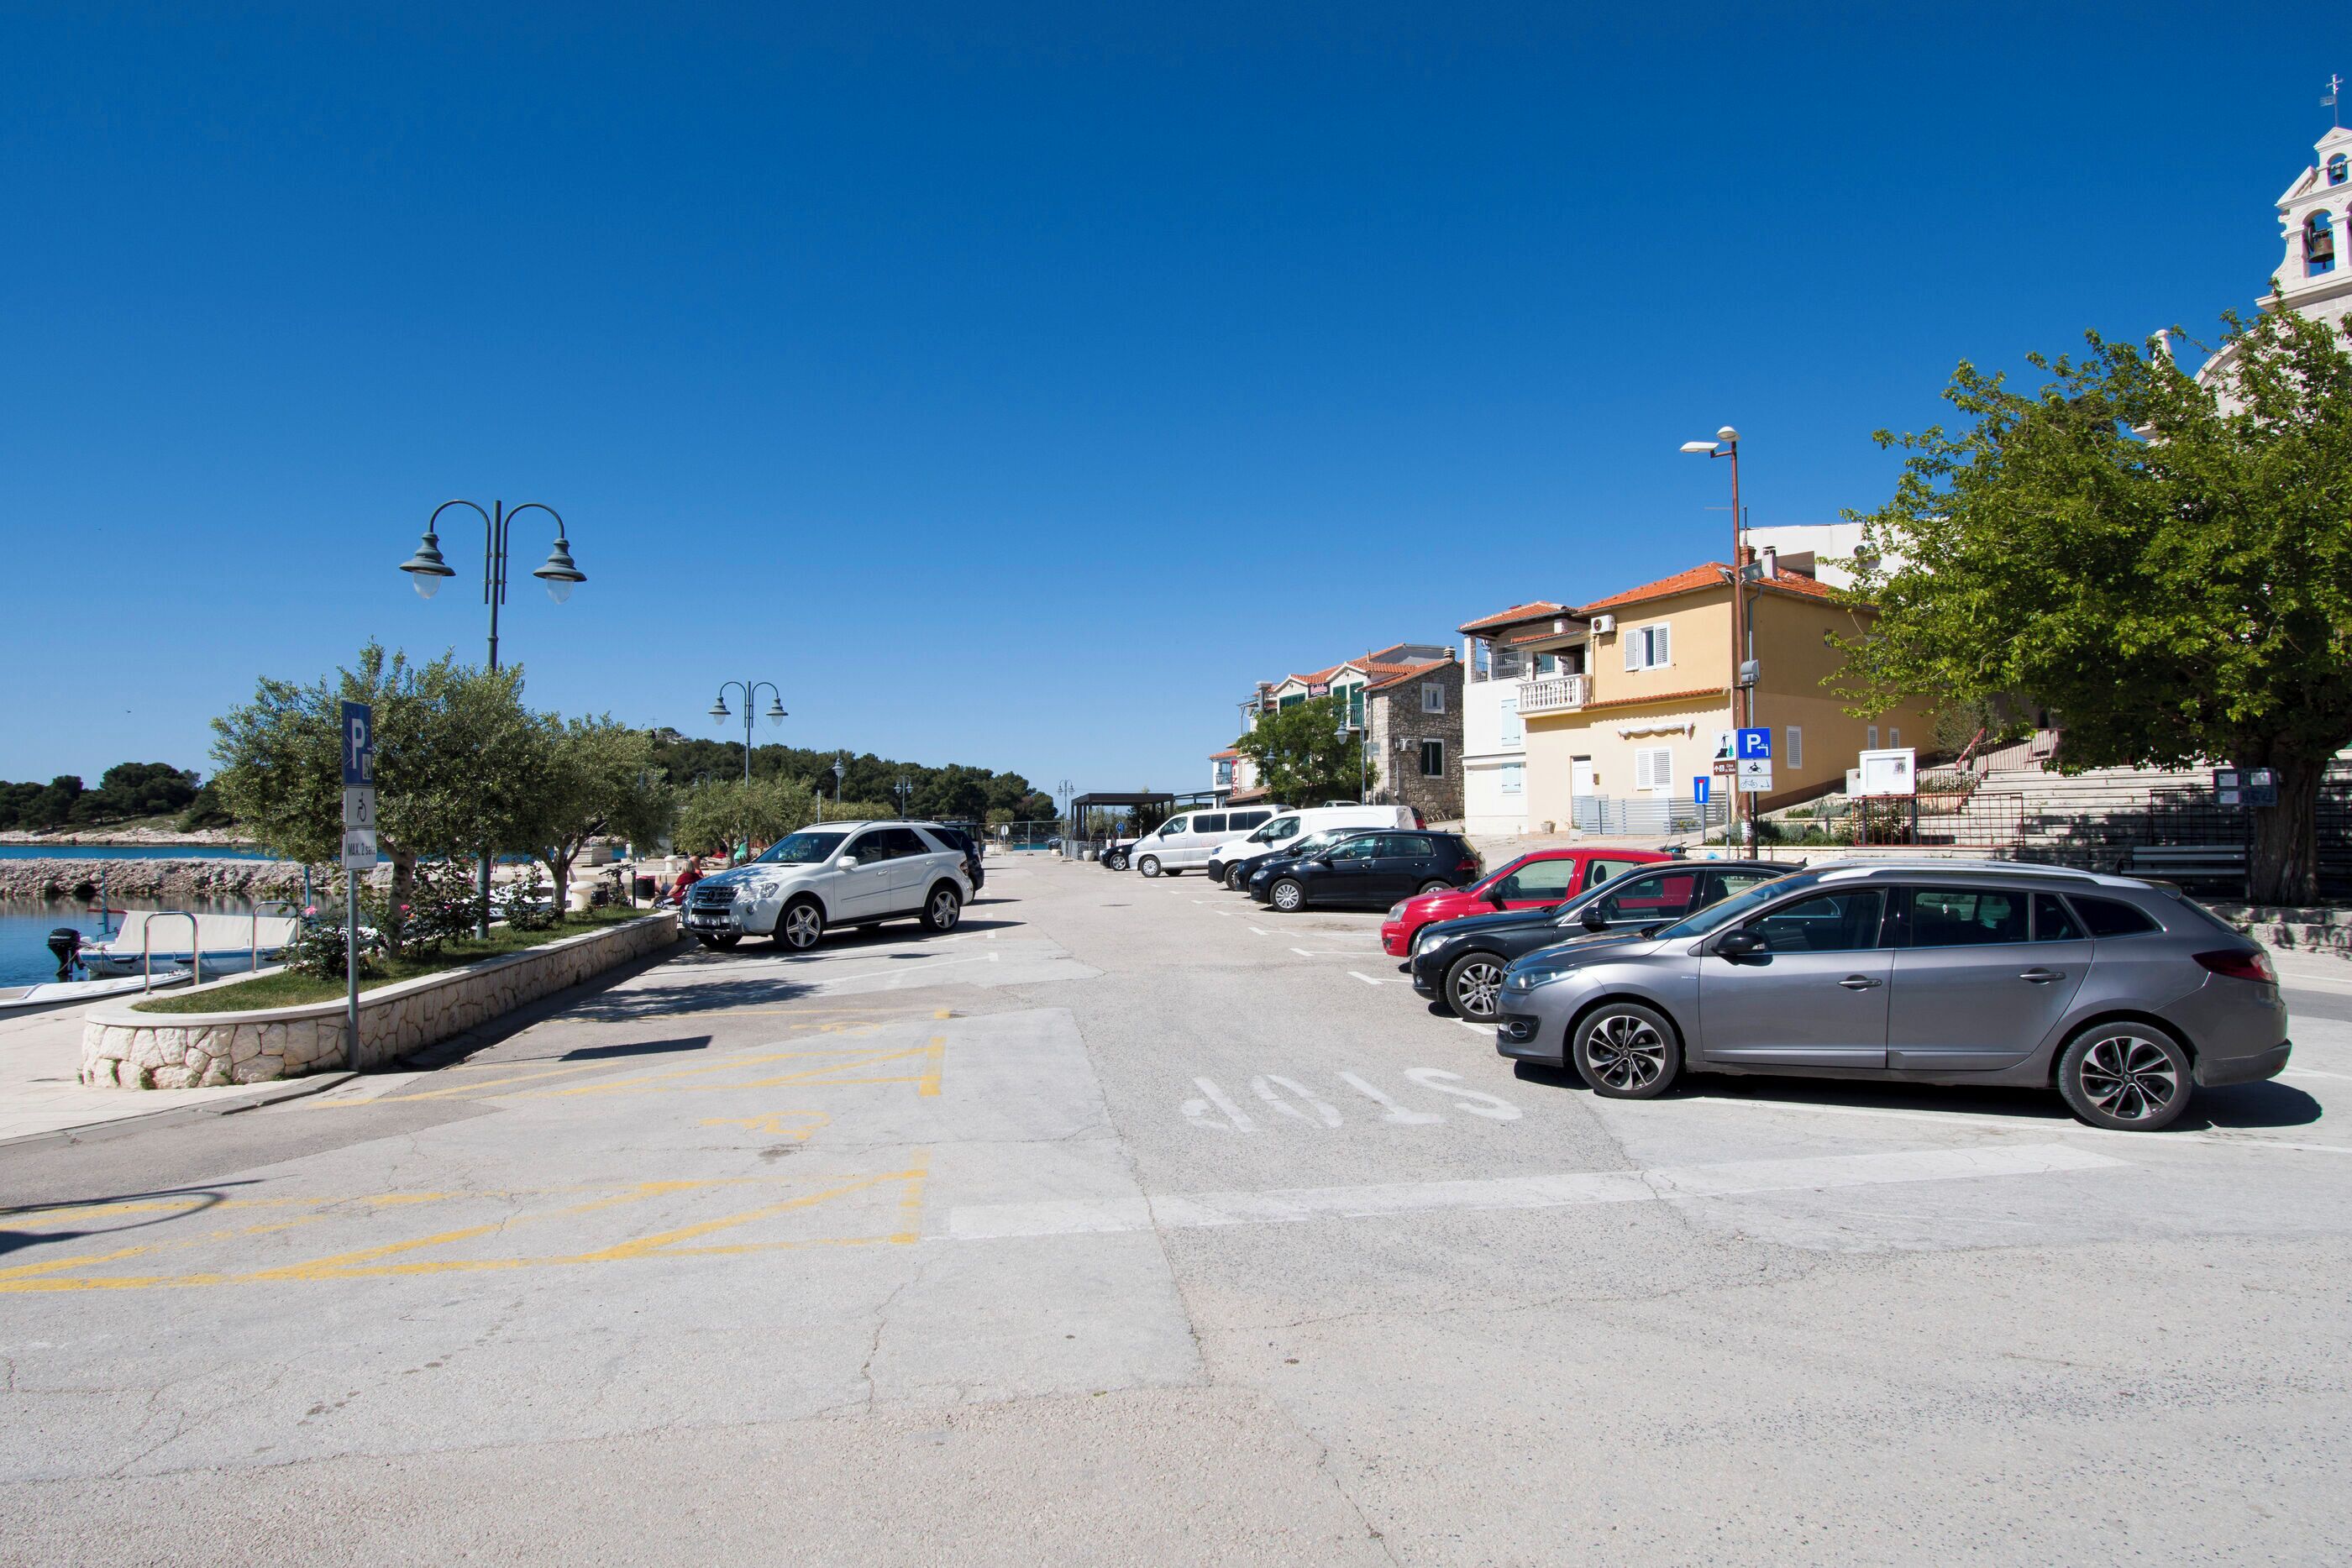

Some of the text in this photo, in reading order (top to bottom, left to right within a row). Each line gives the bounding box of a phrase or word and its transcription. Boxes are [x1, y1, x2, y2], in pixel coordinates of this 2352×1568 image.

[351, 718, 366, 769] P
[1746, 733, 1761, 753] P
[1181, 1067, 1523, 1133] STOP
